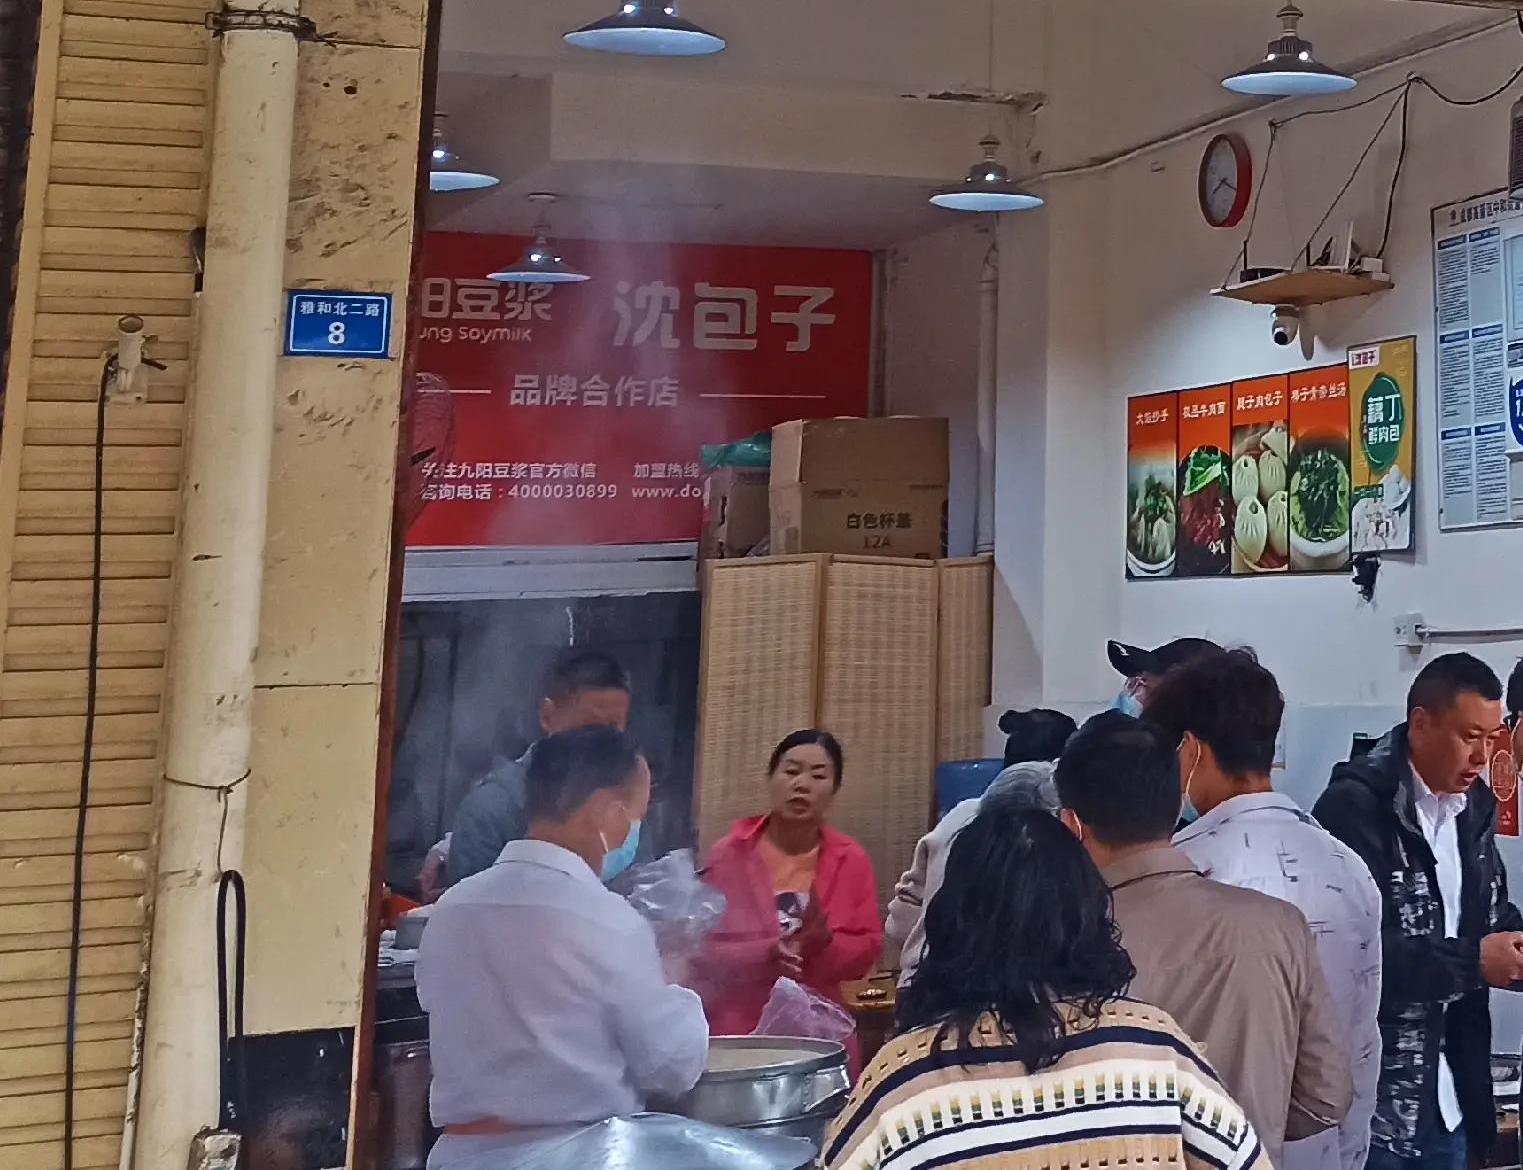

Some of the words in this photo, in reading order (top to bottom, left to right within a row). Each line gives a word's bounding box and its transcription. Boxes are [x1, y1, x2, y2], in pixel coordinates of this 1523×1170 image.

[327, 321, 345, 344] 8
[612, 280, 836, 352] 沈包子
[509, 374, 680, 407] 品牌合作店
